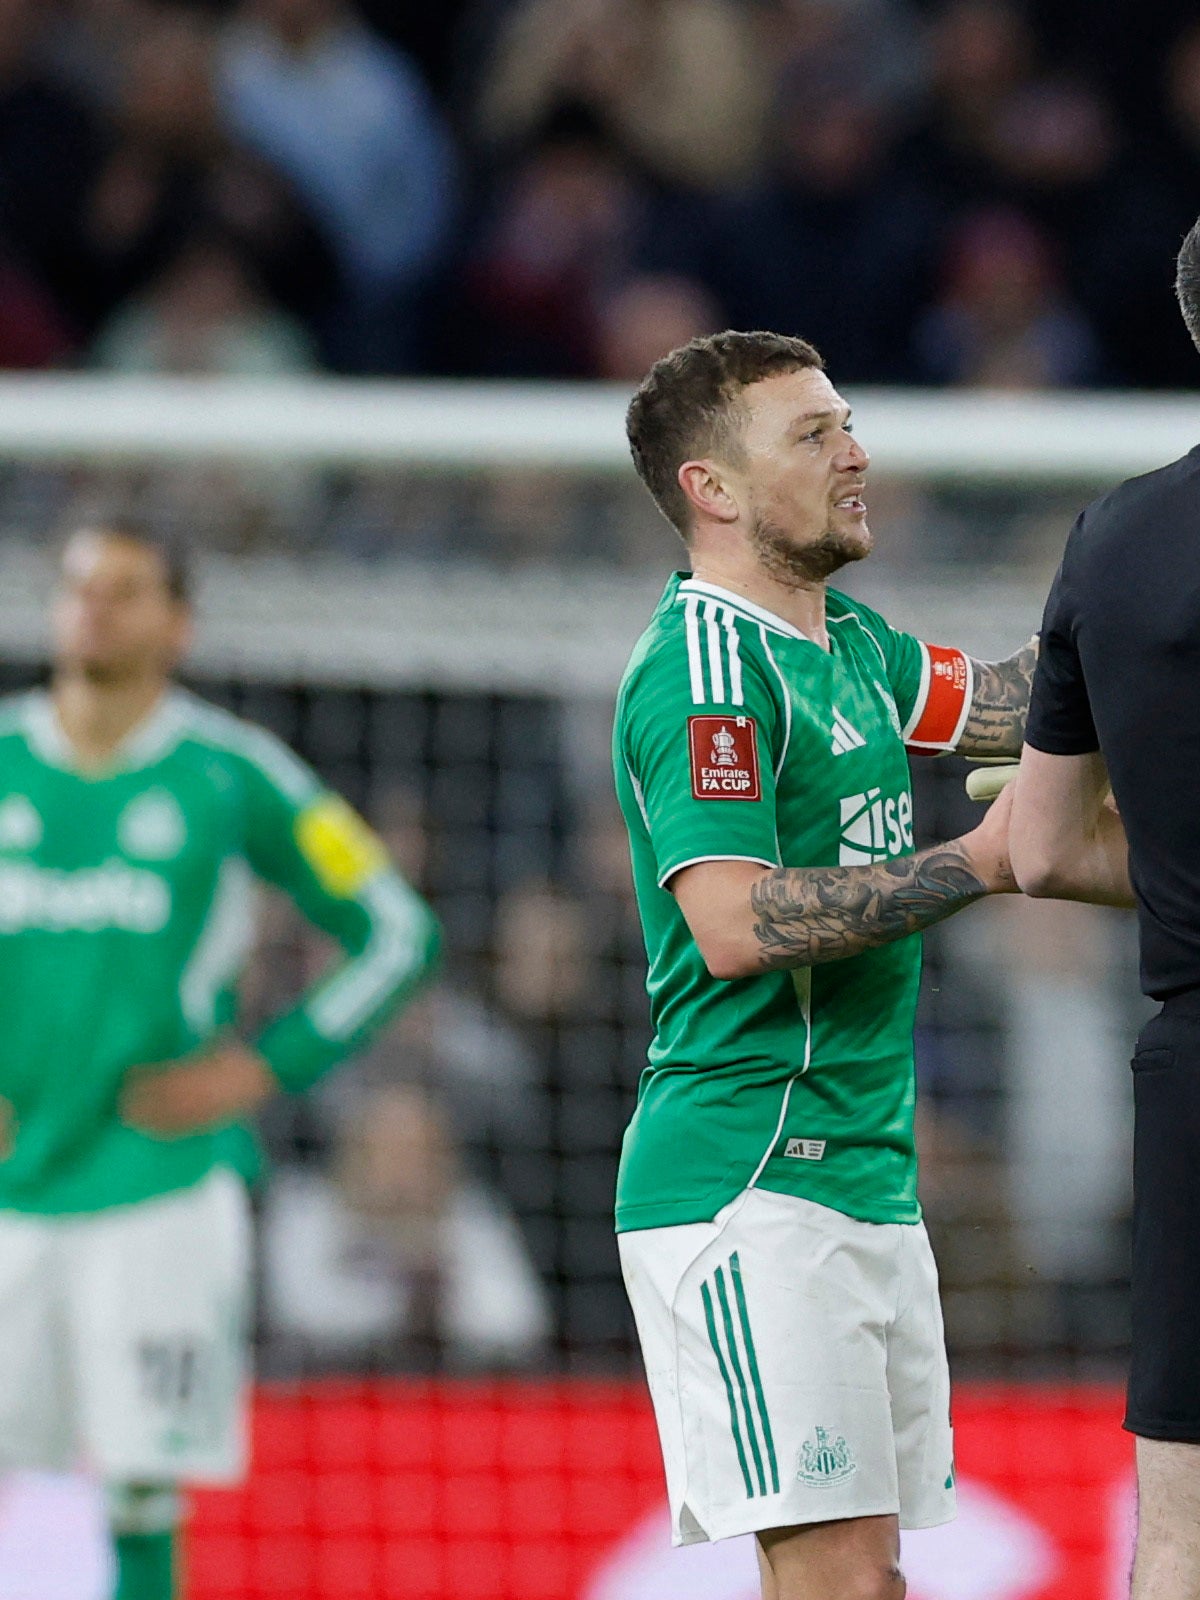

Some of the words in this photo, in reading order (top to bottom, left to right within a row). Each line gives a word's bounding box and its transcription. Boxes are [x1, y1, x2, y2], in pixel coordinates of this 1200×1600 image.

[701, 767, 750, 779] Emirates
[702, 779, 720, 790] FA
[722, 779, 751, 791] CUP
